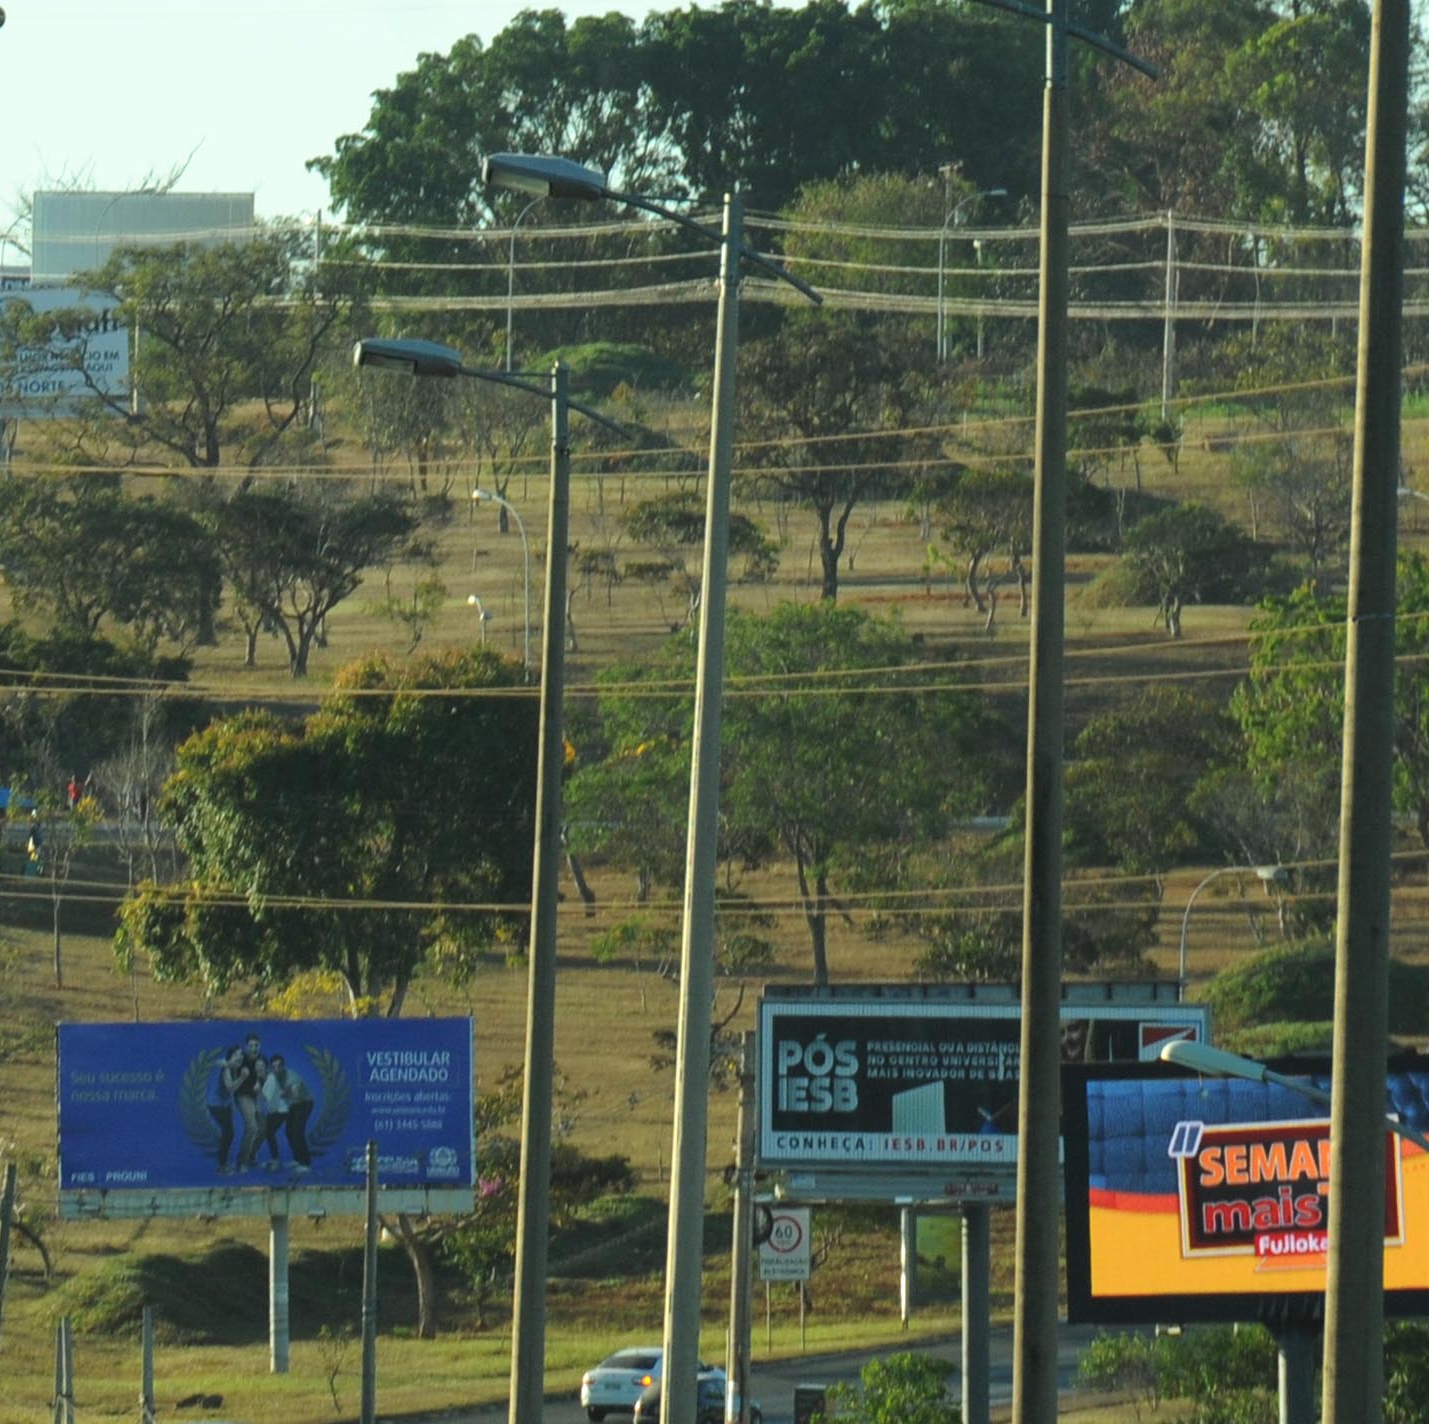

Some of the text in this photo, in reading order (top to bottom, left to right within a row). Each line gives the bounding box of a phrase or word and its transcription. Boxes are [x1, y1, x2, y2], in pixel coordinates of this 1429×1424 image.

[19, 381, 64, 394] NORTE
[867, 1041, 935, 1053] PRESENCIAL
[367, 1051, 451, 1067] VESTIBULAR
[778, 1033, 859, 1077] PÓS
[867, 1054, 885, 1066] NO
[889, 1054, 938, 1066] CENTRO
[369, 1067, 449, 1083] AGENDADO
[867, 1067, 898, 1079] MAIS
[902, 1067, 965, 1079] INOVADOR
[778, 1077, 859, 1112] IESB
[884, 1137, 1004, 1152] IESB.BR/POS
[105, 1170, 148, 1182] PROUNI
[1203, 1187, 1322, 1233] mais
[775, 1225, 793, 1239] 60
